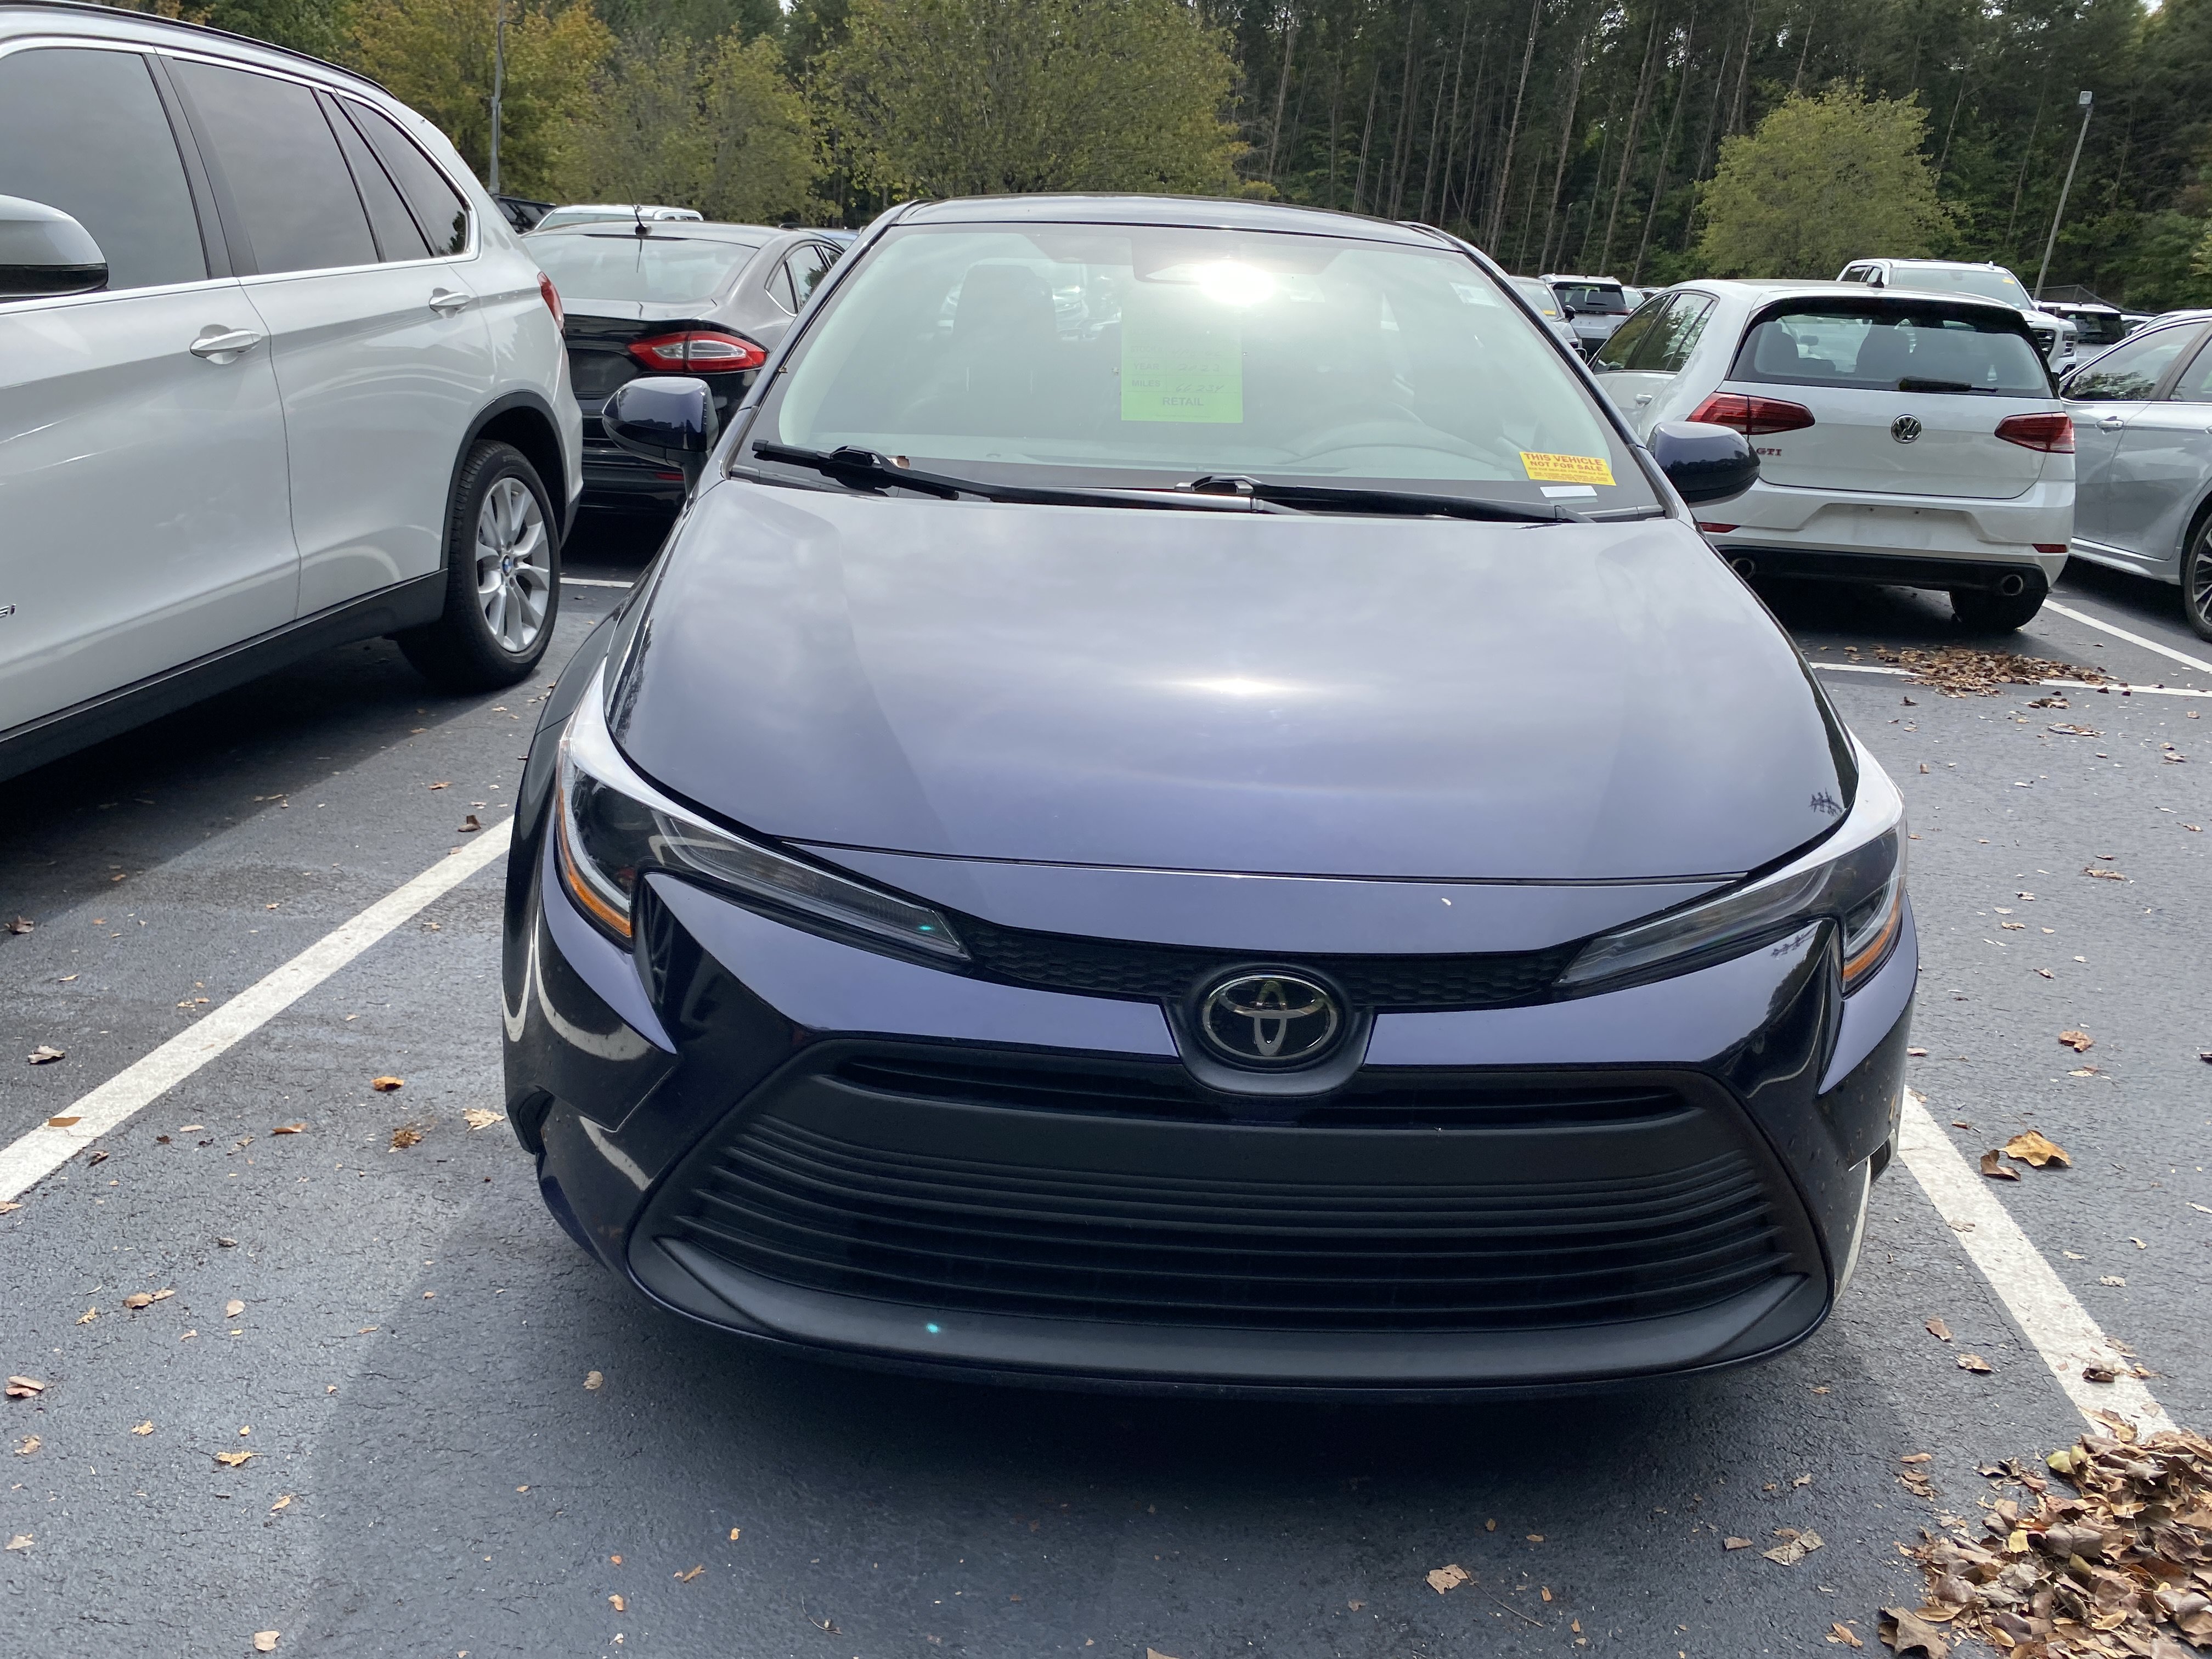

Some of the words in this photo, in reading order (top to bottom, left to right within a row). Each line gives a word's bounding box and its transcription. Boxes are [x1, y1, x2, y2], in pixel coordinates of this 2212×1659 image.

[1163, 397, 1204, 406] RETAIL
[1756, 448, 1782, 456] GTI
[1553, 455, 1602, 465] VEHICLE
